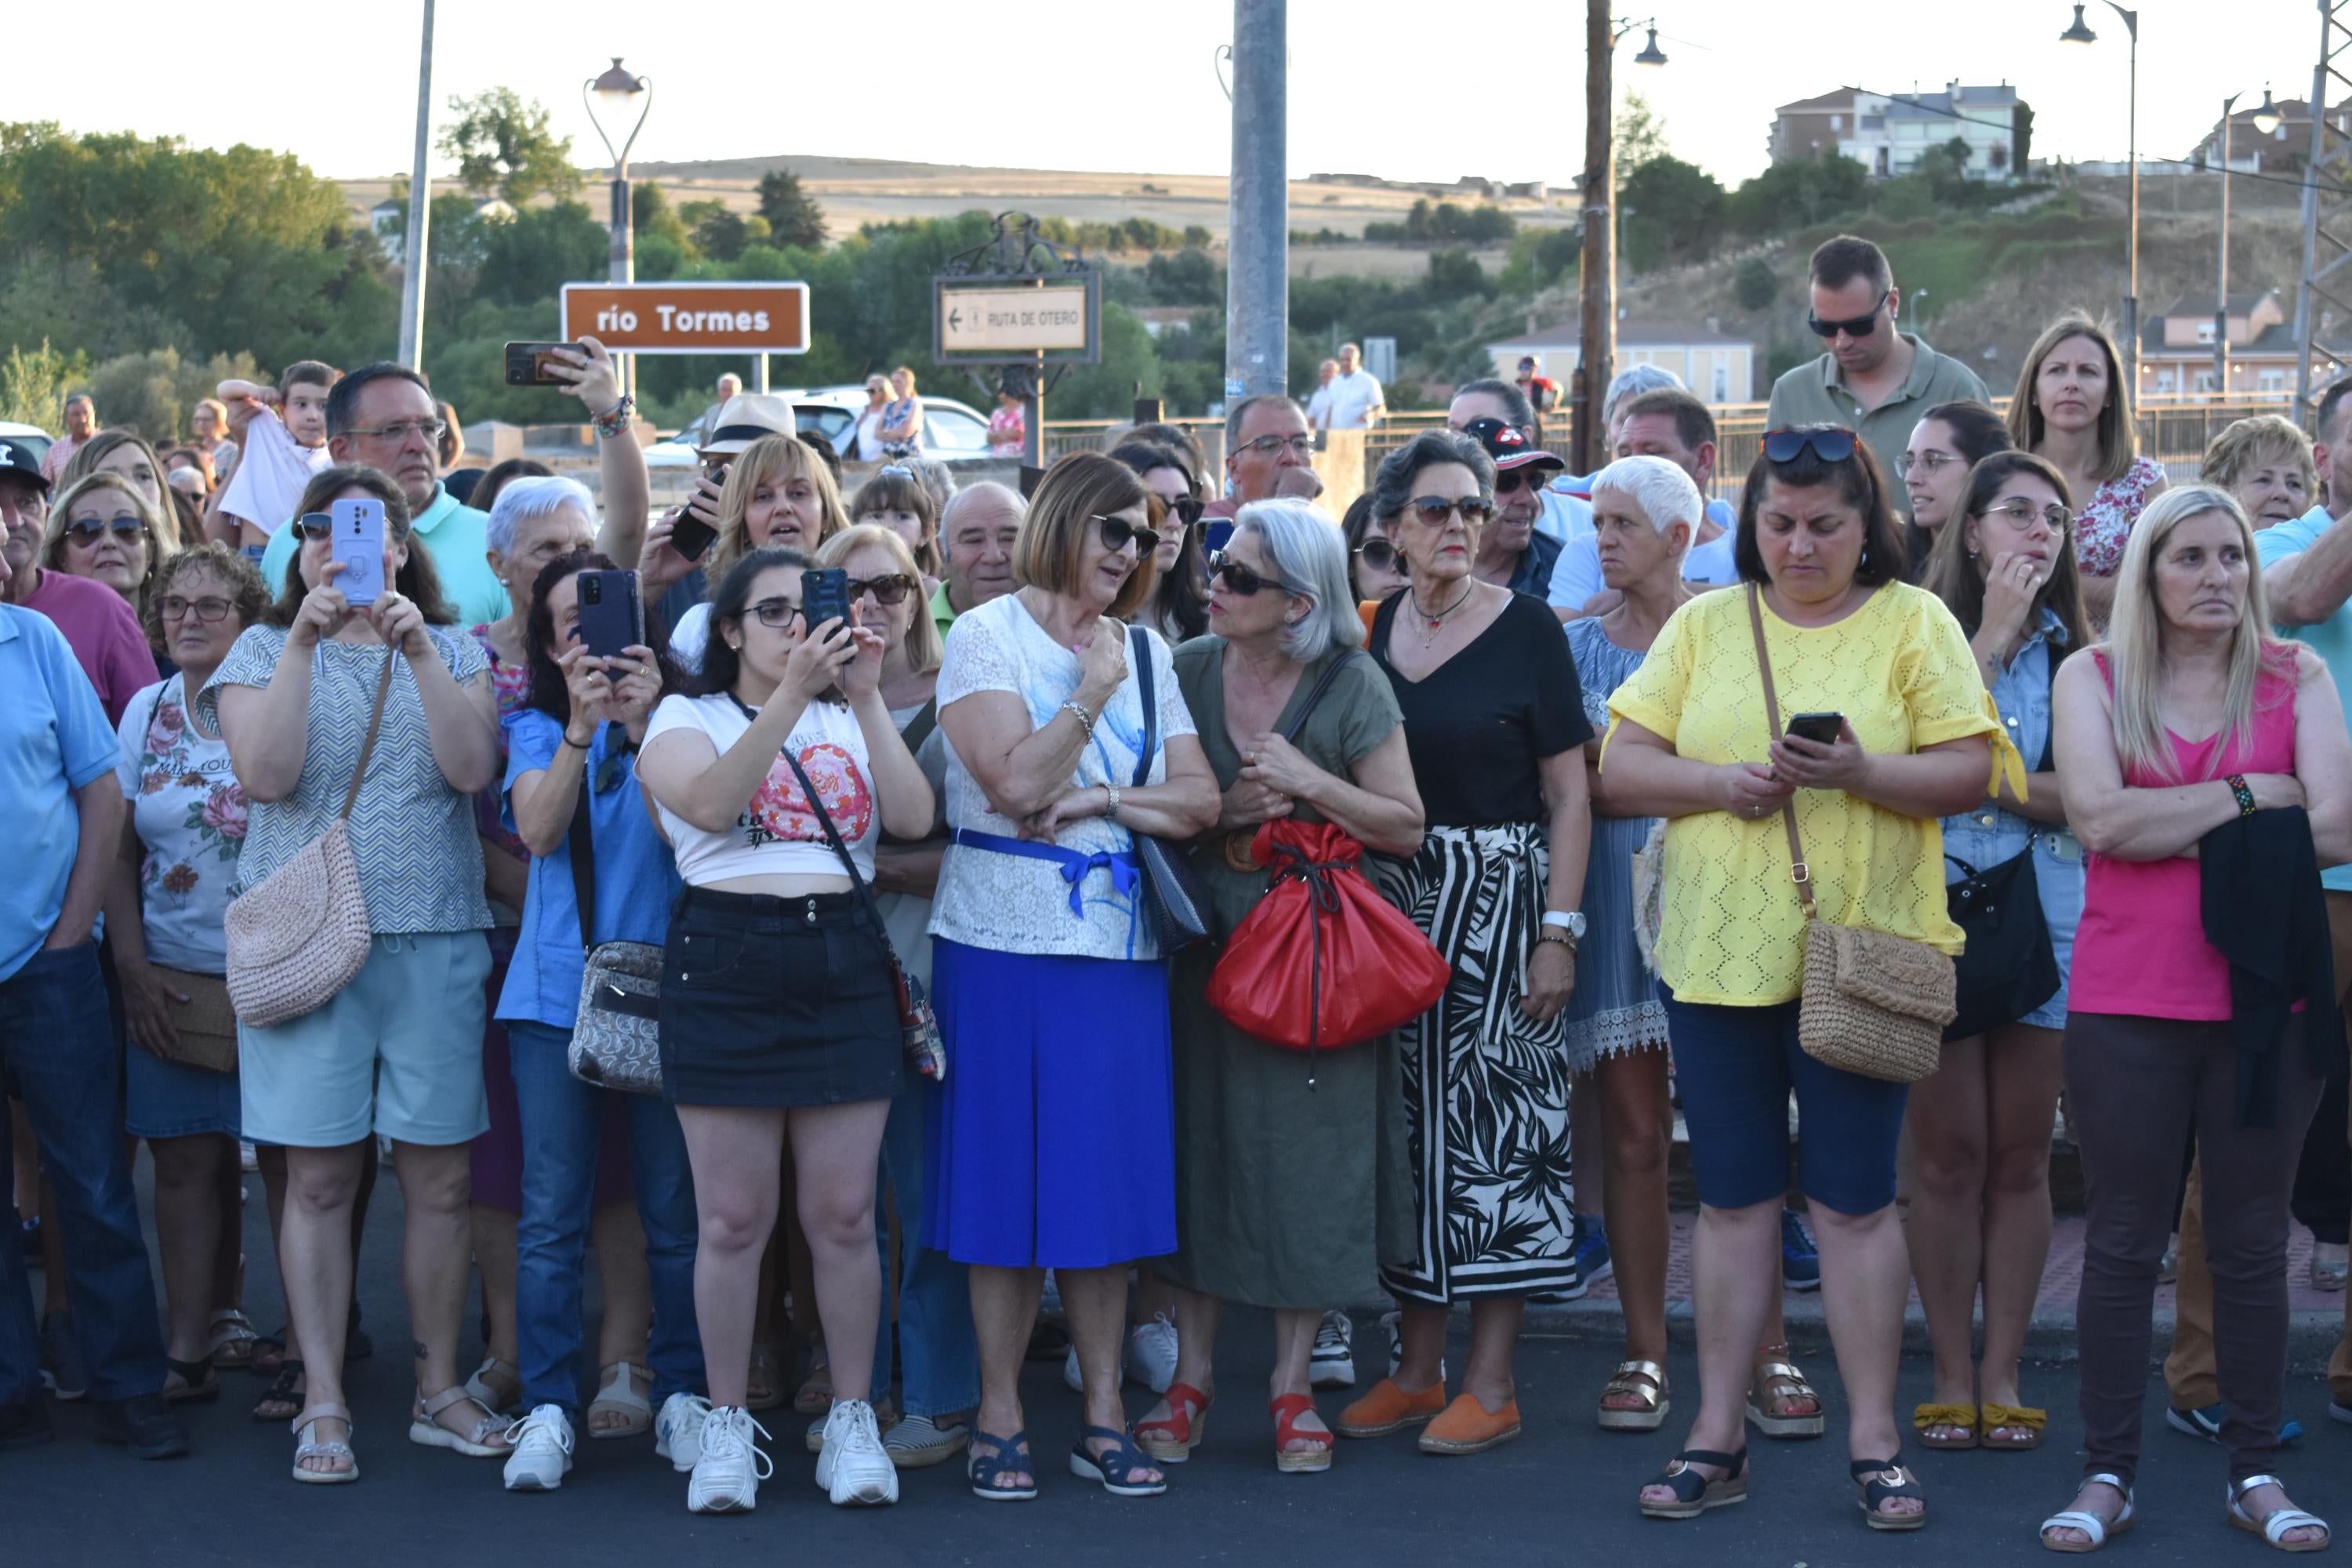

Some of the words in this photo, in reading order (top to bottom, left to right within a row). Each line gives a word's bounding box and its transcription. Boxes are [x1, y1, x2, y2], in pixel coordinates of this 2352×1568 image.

[597, 304, 637, 332] río
[655, 304, 771, 332] Tormes
[988, 313, 1018, 327] RUTA
[1021, 311, 1036, 327] DE
[1039, 310, 1079, 326] OTERO
